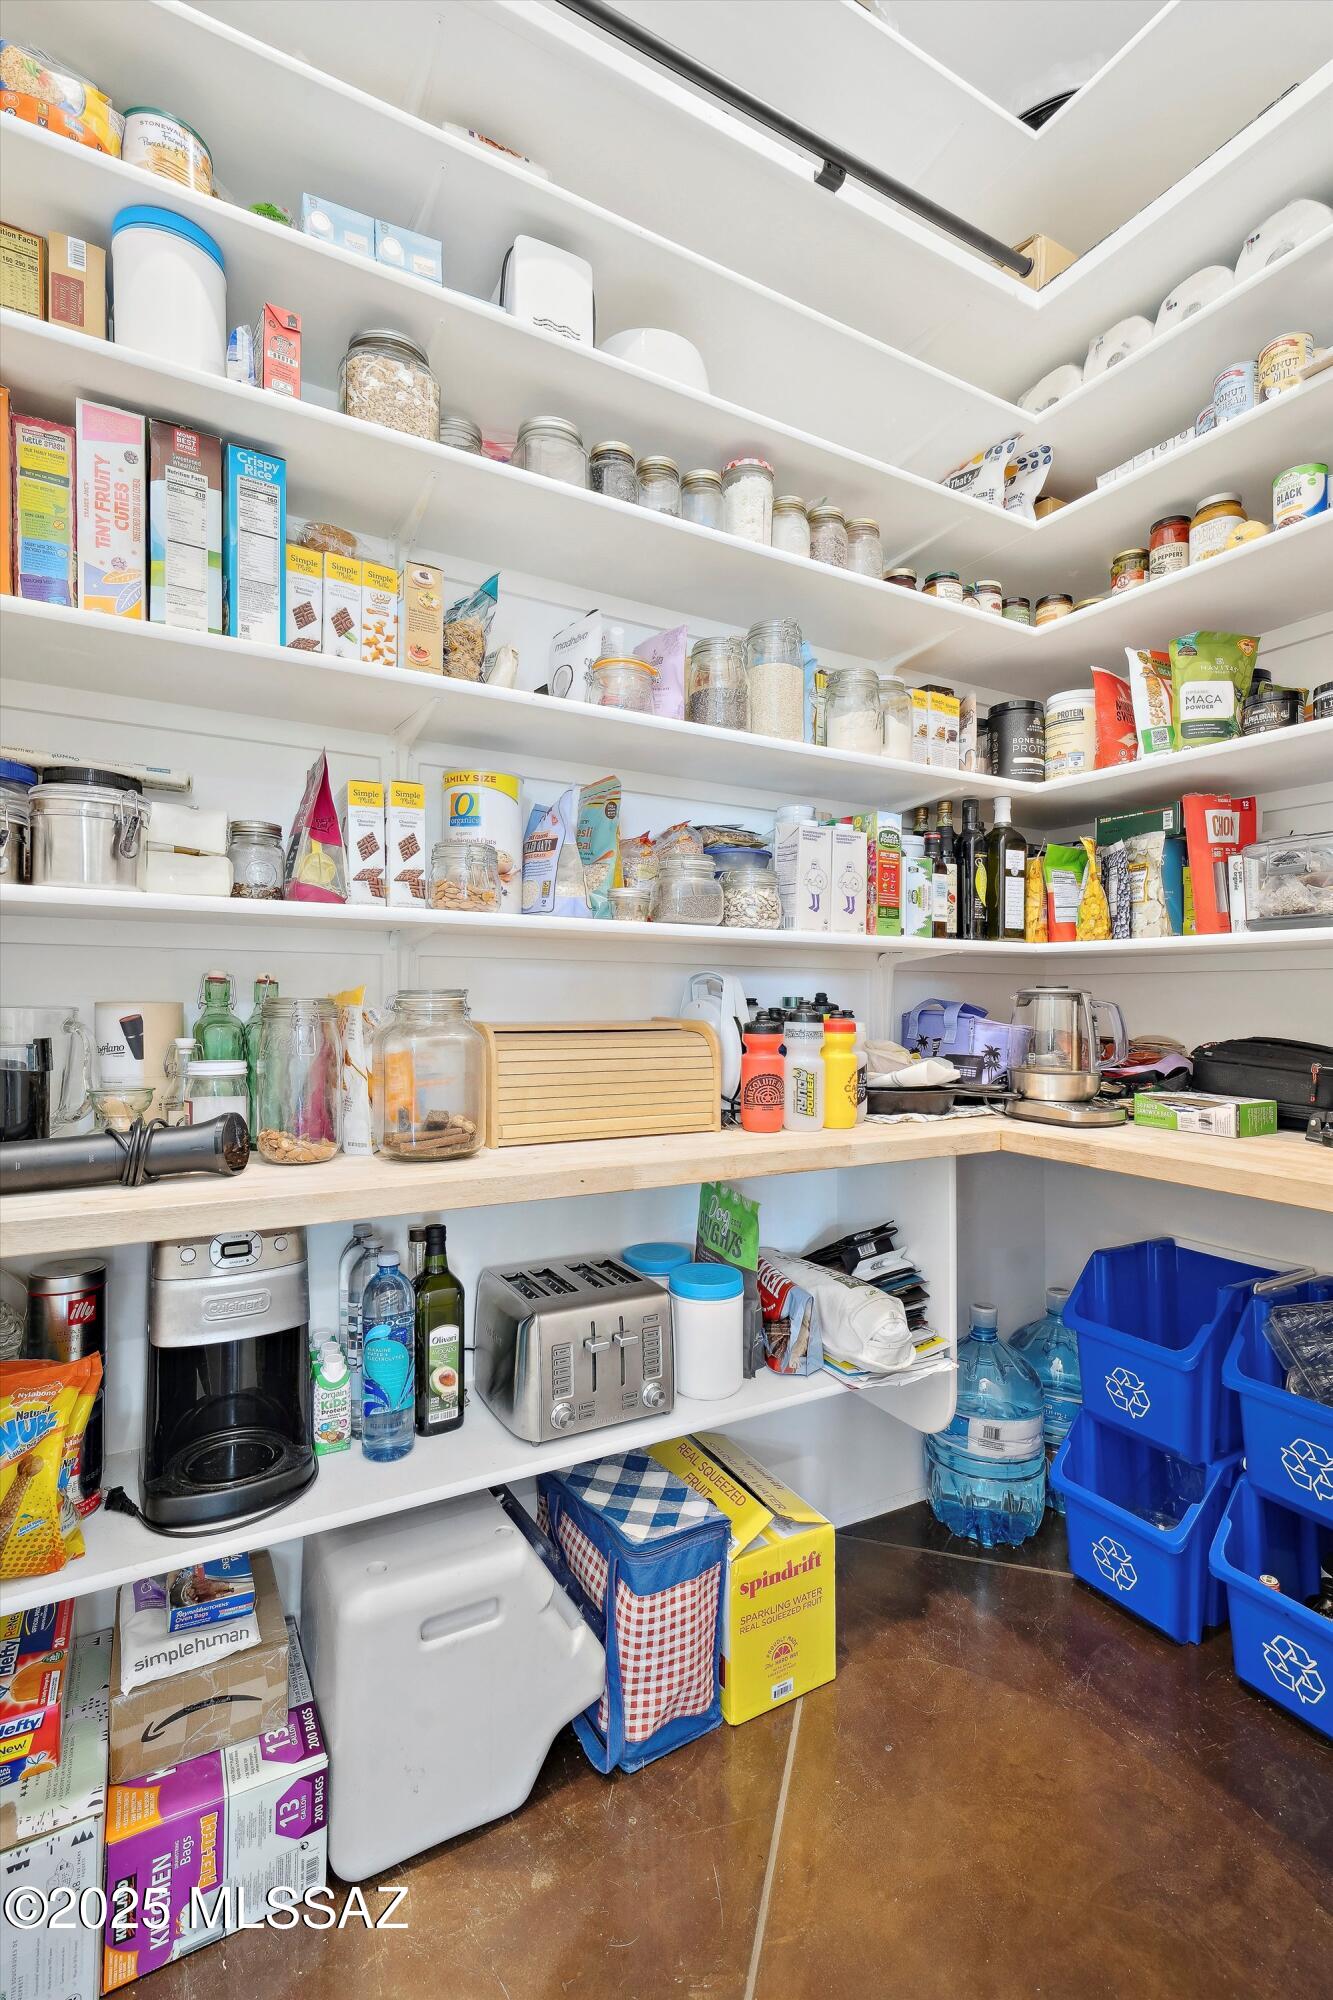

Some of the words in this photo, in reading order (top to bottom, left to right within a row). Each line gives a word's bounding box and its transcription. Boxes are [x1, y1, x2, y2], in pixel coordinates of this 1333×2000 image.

[18, 232, 38, 247] Facts
[1259, 356, 1300, 382] OCONUT
[236, 451, 280, 474] Crispy
[244, 463, 273, 481] Rice
[1276, 486, 1303, 506] BLACK
[290, 554, 319, 569] Simple
[1157, 551, 1184, 564] PEPPERS
[331, 561, 358, 576] Simple
[367, 570, 394, 584] Simple
[1185, 694, 1223, 704] MACA
[1056, 708, 1085, 721] PROTEIN
[1260, 710, 1278, 722] BRAIN
[1012, 736, 1035, 744] BONE
[1012, 744, 1046, 755] PROTE
[472, 774, 497, 784] SIZE
[353, 789, 380, 798] Simple
[395, 790, 421, 799] Simple
[1242, 800, 1250, 808] 12
[450, 815, 480, 827] organics
[747, 1077, 776, 1104] ABSOLUTE
[806, 1073, 815, 1116] POWER
[70, 1300, 95, 1322] illy
[209, 1296, 266, 1314] Cuisinart
[432, 1334, 457, 1346] Olivari
[17, 1388, 58, 1400] Nylabone
[320, 1390, 347, 1400] Orgain
[16, 1404, 51, 1422] Natural
[677, 1442, 700, 1467] REAL
[697, 1461, 747, 1507] SQUEEZED
[683, 1472, 713, 1498] FRUIT
[739, 1551, 823, 1600] spindrift
[740, 1599, 791, 1626] SPARKLING
[792, 1587, 823, 1604] WATER
[175, 1614, 193, 1624] Oven
[193, 1611, 209, 1621] Bags
[739, 1619, 760, 1636] REAL
[761, 1605, 802, 1628] SQUEEZED
[802, 1596, 823, 1611] FRUIT
[53, 1636, 66, 1649] 20
[134, 1628, 250, 1673] simplehuman
[301, 1707, 316, 1732] BAGS
[306, 1731, 321, 1750] 200
[314, 1775, 325, 1802] BAGS
[279, 1798, 300, 1829] 13
[314, 1803, 324, 1824] 200
[179, 1834, 195, 1869] Bags
[198, 1811, 219, 1889] FLEX-TECH
[149, 1852, 173, 1951] KICHEN
